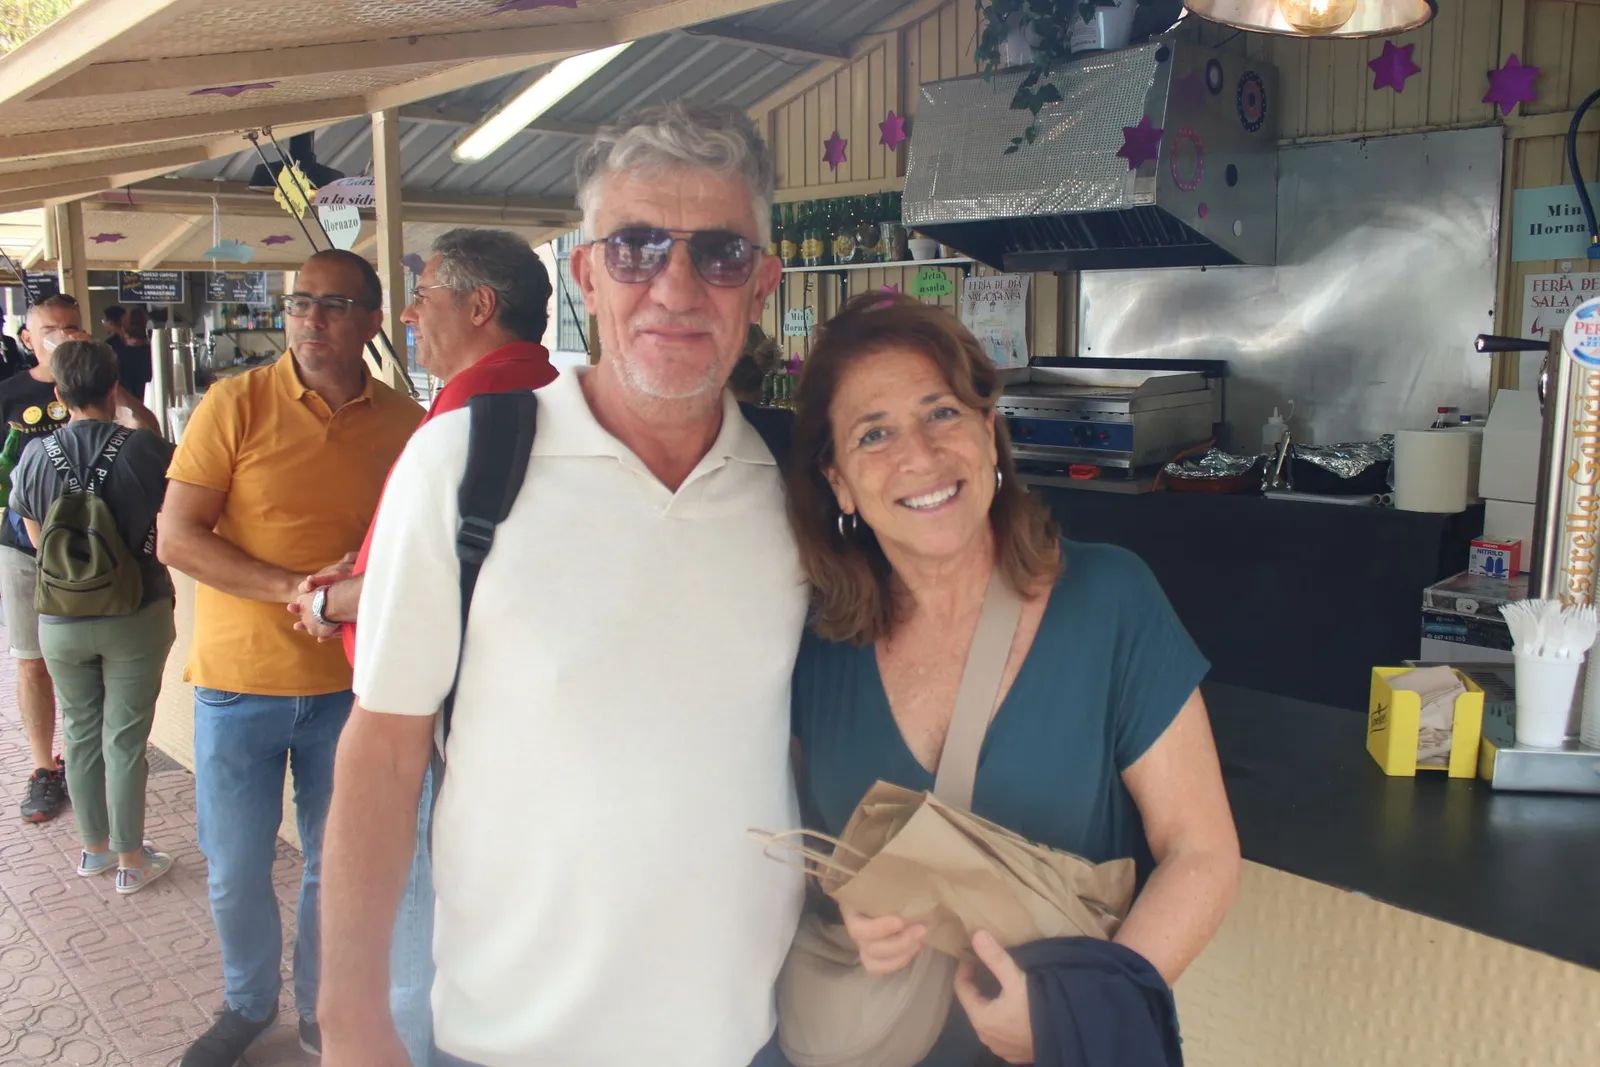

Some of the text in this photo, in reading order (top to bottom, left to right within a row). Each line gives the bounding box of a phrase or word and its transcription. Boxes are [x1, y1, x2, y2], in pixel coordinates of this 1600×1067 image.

[332, 193, 345, 204] la
[347, 193, 376, 206] sidr
[1547, 204, 1582, 217] Min
[1528, 223, 1586, 236] Horna
[1531, 295, 1586, 308] SALAM
